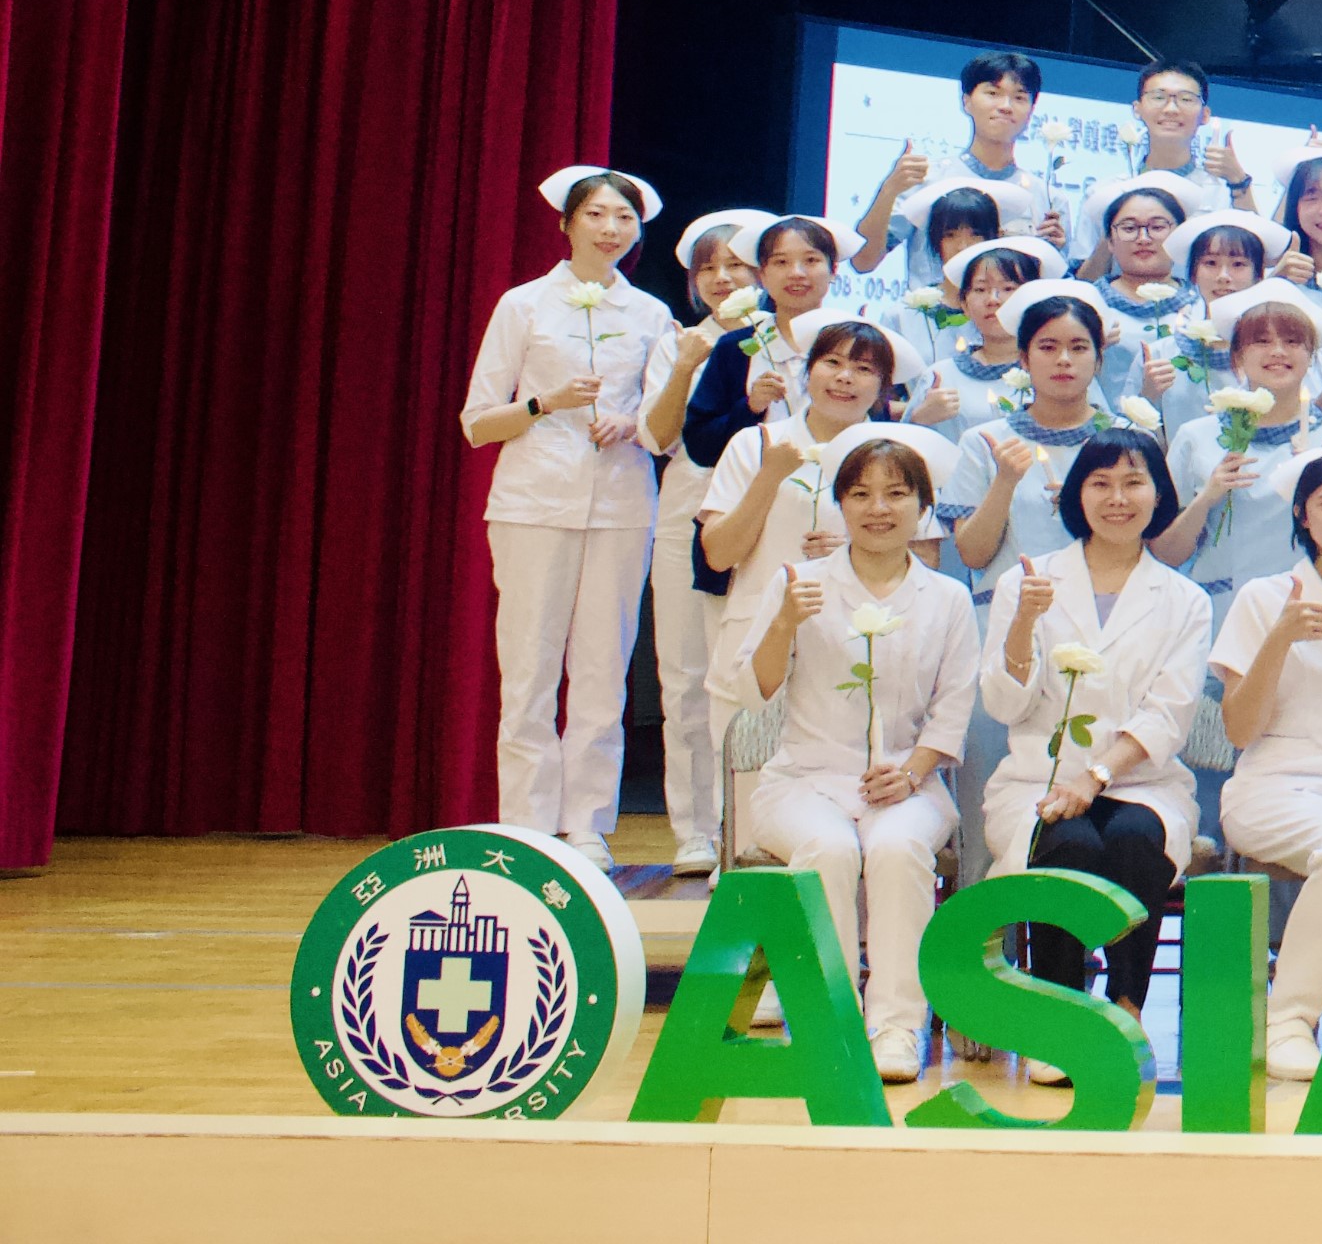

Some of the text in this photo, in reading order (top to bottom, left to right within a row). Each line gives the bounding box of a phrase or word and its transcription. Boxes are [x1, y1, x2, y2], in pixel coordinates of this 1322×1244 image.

[350, 843, 572, 910] 亞洲大學
[314, 1039, 368, 1112] ASIA
